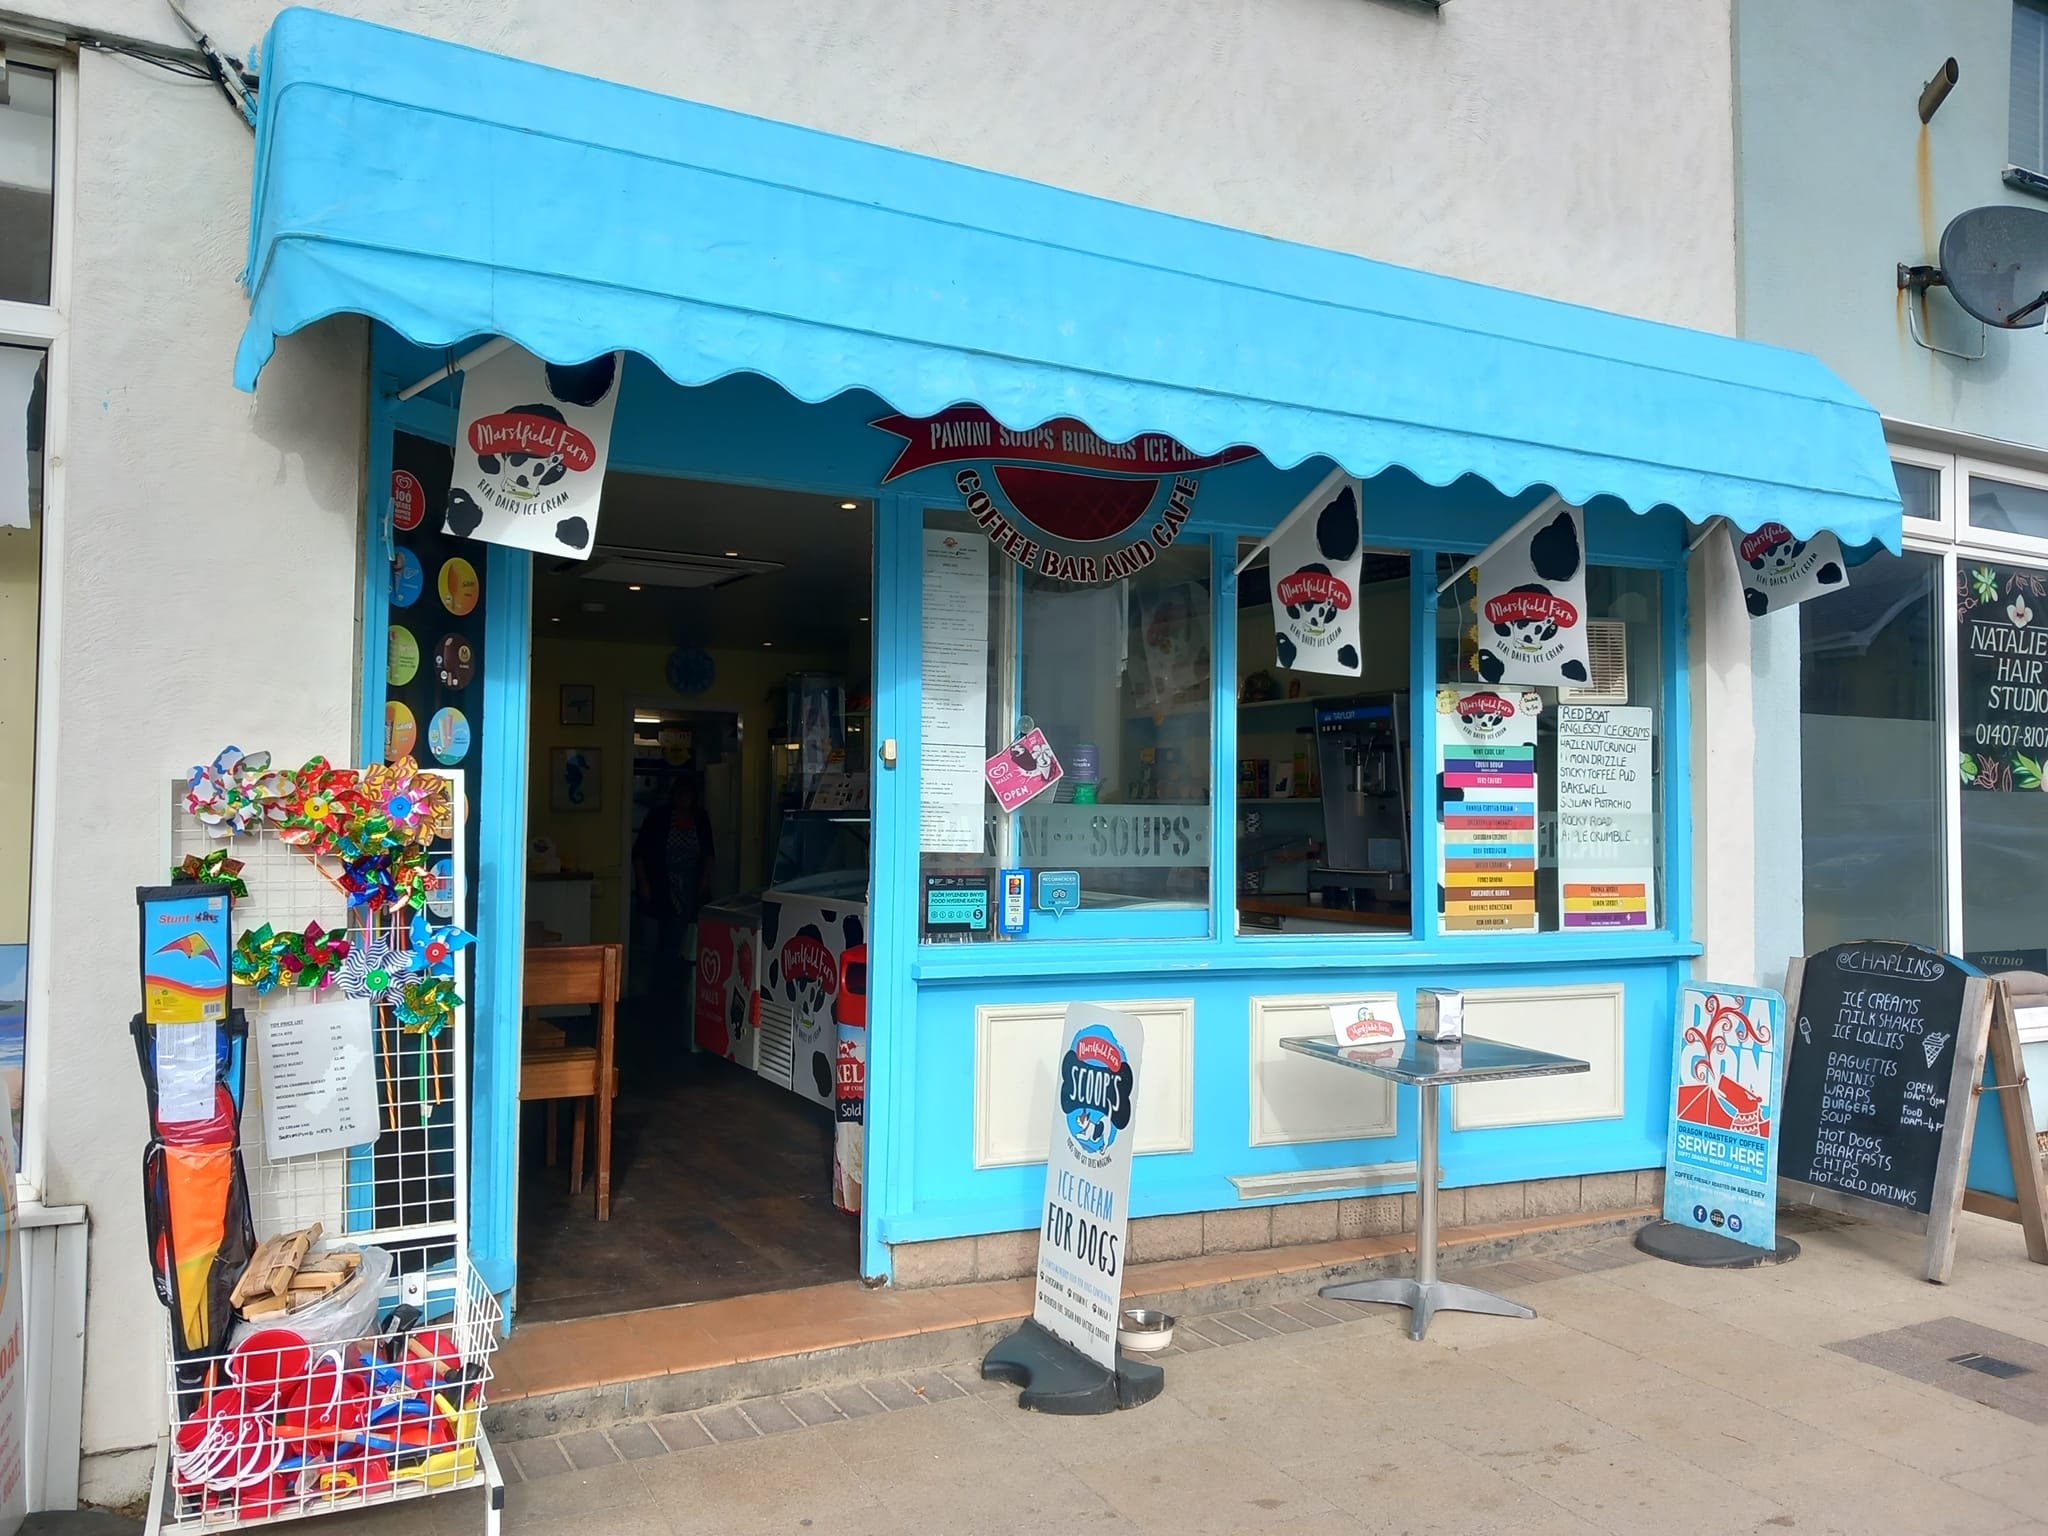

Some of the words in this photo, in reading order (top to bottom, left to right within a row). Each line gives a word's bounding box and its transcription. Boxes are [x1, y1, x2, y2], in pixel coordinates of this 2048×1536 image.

[477, 421, 556, 450] Marshfield
[558, 430, 589, 463] Farm
[930, 421, 991, 450] PANINI
[999, 427, 1054, 450] SOUPS
[1061, 430, 1136, 461] BURGERS
[1143, 438, 1168, 462] ICE
[477, 478, 495, 500] REAL
[495, 495, 520, 514] DAIRY
[523, 503, 537, 515] ICE
[541, 491, 569, 515] CREAM
[955, 467, 1038, 569] COFFEE
[1039, 548, 1098, 583] BAR
[1101, 538, 1157, 582] AND
[1151, 474, 1198, 548] CAFE
[1790, 572, 1801, 582] ICE
[1801, 552, 1818, 575] CREAM
[1280, 577, 1327, 603] Marshfield
[1328, 580, 1348, 603] Farm
[1490, 597, 1548, 621] Marshfield
[1548, 599, 1573, 622] Farm
[1326, 626, 1342, 646] CREAM
[1496, 640, 1510, 655] REAL
[1511, 651, 1530, 663] DAIRY
[1533, 654, 1544, 664] ICE
[1545, 643, 1565, 661] CREAM
[1997, 658, 2043, 684] HAIR
[1497, 700, 1513, 713] Farm
[1988, 685, 2048, 714] STUDIO
[1560, 722, 1601, 735] ANGLESEY
[1003, 785, 1029, 801] OPEN
[1561, 782, 1607, 794] BAKEWELL
[1561, 813, 1587, 826] ROCKY
[1590, 816, 1613, 826] ROAD
[1089, 815, 1190, 857] SOUPS
[1589, 830, 1631, 843] CRUMBLE
[159, 914, 189, 924] Stunt
[975, 910, 981, 919] 5
[1849, 951, 1933, 978] CHAPLINS
[1981, 955, 2023, 967] STUDIO
[1841, 991, 1864, 1009] ICE
[1868, 993, 1921, 1015] CREAMS
[1832, 1023, 1851, 1040] ICE
[1856, 1027, 1905, 1050] LOLLIES
[1827, 1051, 1898, 1077] BAGUETTES
[1070, 1065, 1121, 1112] SCOOP'S
[1826, 1067, 1875, 1088] PANINIS
[1906, 1081, 1934, 1094] OPEN
[1822, 1096, 1877, 1116] BURGERS
[1824, 1083, 1871, 1103] WRAPS
[841, 1103, 862, 1118] Sold
[1820, 1110, 1852, 1125] SOUP
[1677, 1134, 1726, 1159] SERVED
[1729, 1145, 1765, 1168] HERE
[1678, 1125, 1703, 1137] DRAGON
[1704, 1131, 1737, 1144] ROASTERY
[1739, 1138, 1765, 1151] COFFEE
[1818, 1127, 1846, 1143] HOT
[1849, 1133, 1883, 1154] DOGS
[1813, 1156, 1860, 1178] CHIPS
[1057, 1168, 1075, 1203] ICE
[1077, 1174, 1114, 1223] CREAM
[1674, 1171, 1694, 1181] COFFEE
[1737, 1186, 1765, 1199] ANGLESEY
[1871, 1181, 1917, 1207] DRINKS
[1046, 1201, 1072, 1253] FOR
[1077, 1217, 1119, 1277] DOGS
[0, 1318, 20, 1380] oat
